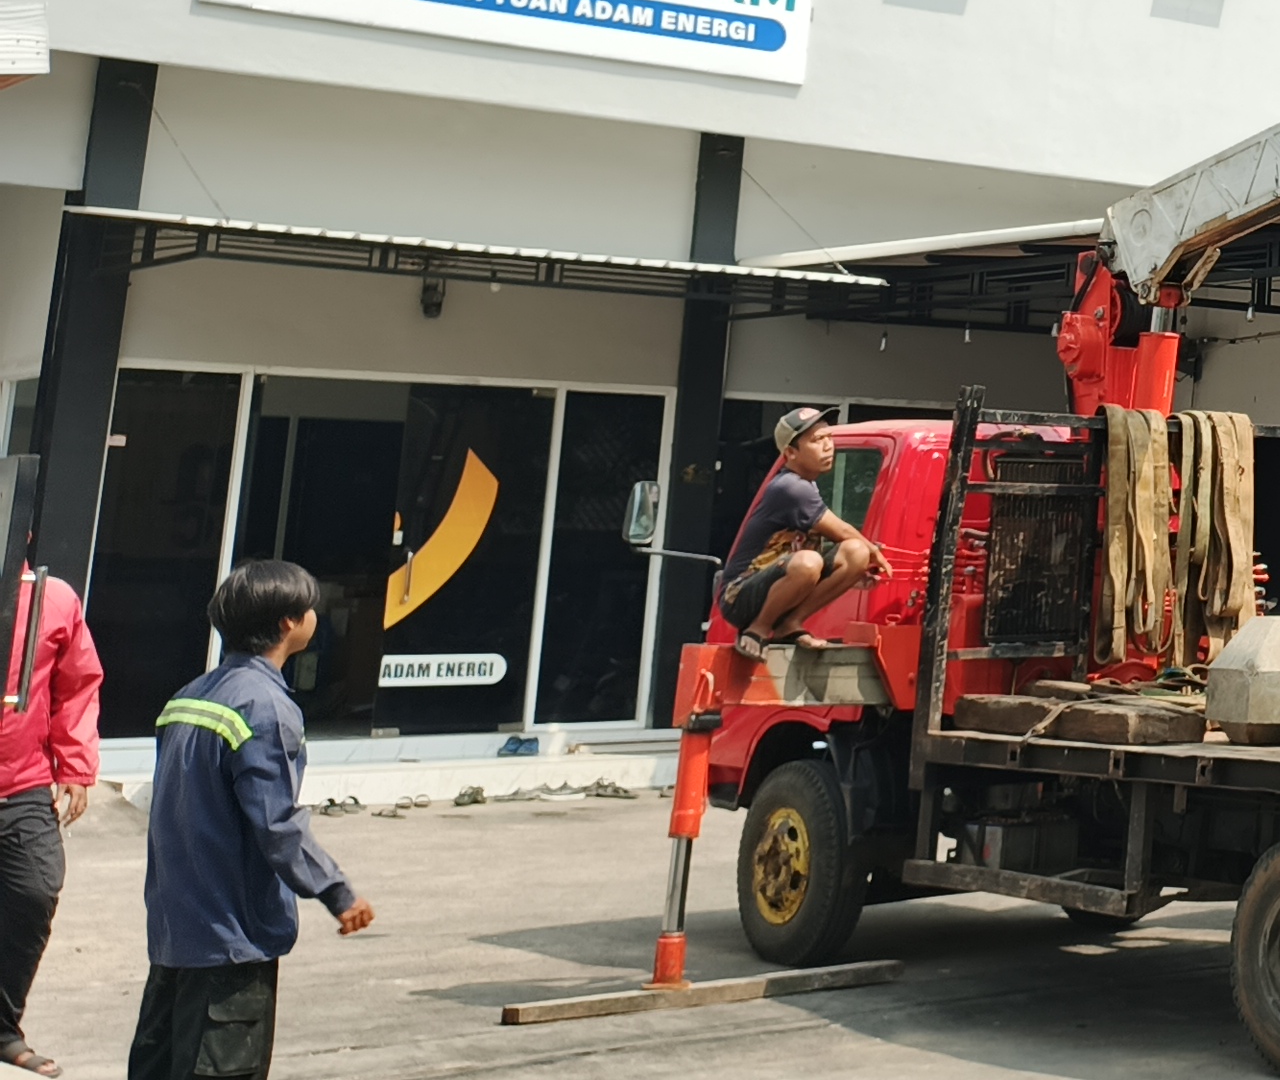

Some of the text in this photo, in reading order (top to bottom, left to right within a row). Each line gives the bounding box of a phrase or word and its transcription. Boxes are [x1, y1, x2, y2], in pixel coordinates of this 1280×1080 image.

[660, 10, 756, 42] ENERGI
[382, 661, 494, 678] ADAM ENERGI
